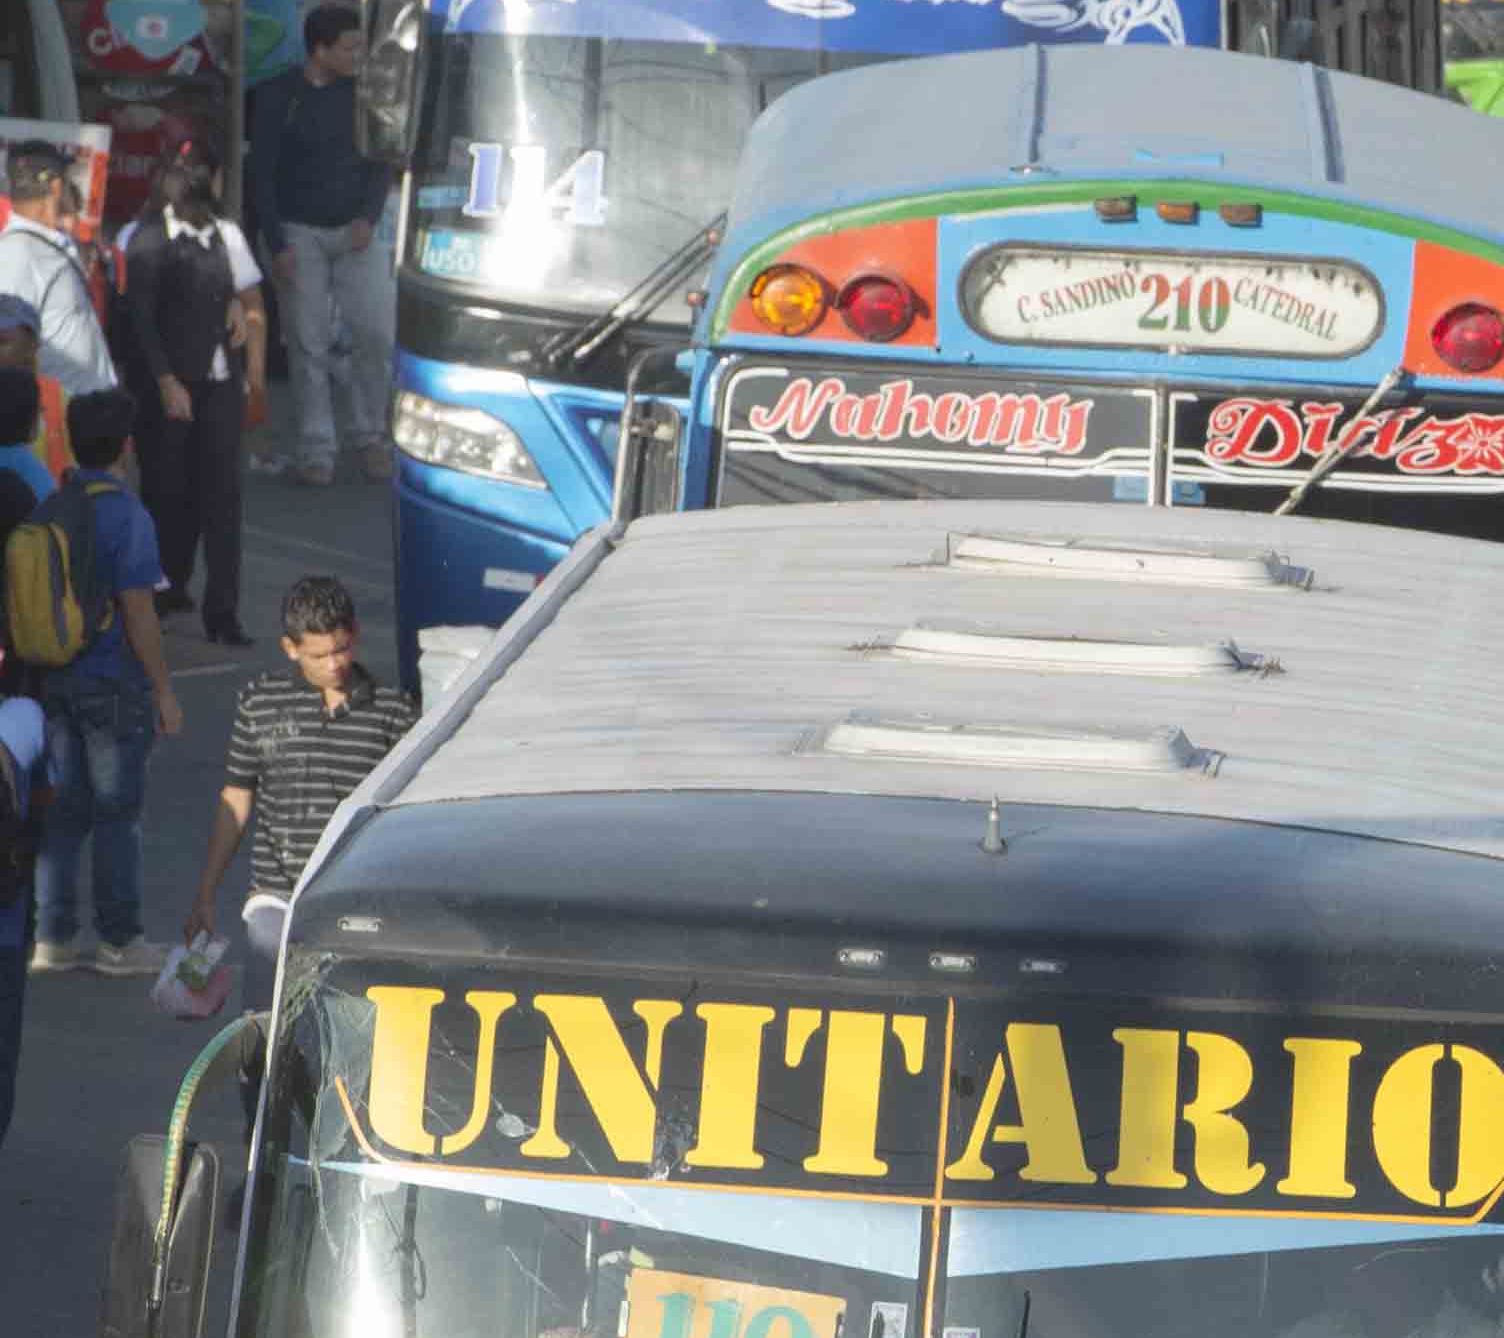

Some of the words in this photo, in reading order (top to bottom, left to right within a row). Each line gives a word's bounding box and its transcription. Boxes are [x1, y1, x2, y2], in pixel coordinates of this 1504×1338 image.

[462, 143, 609, 225] 114
[1017, 294, 1039, 323] C.
[1041, 269, 1136, 317] SANDINO
[1137, 273, 1231, 334] 210
[1233, 283, 1341, 341] CATEDRAL
[751, 377, 1094, 455] Nahomy
